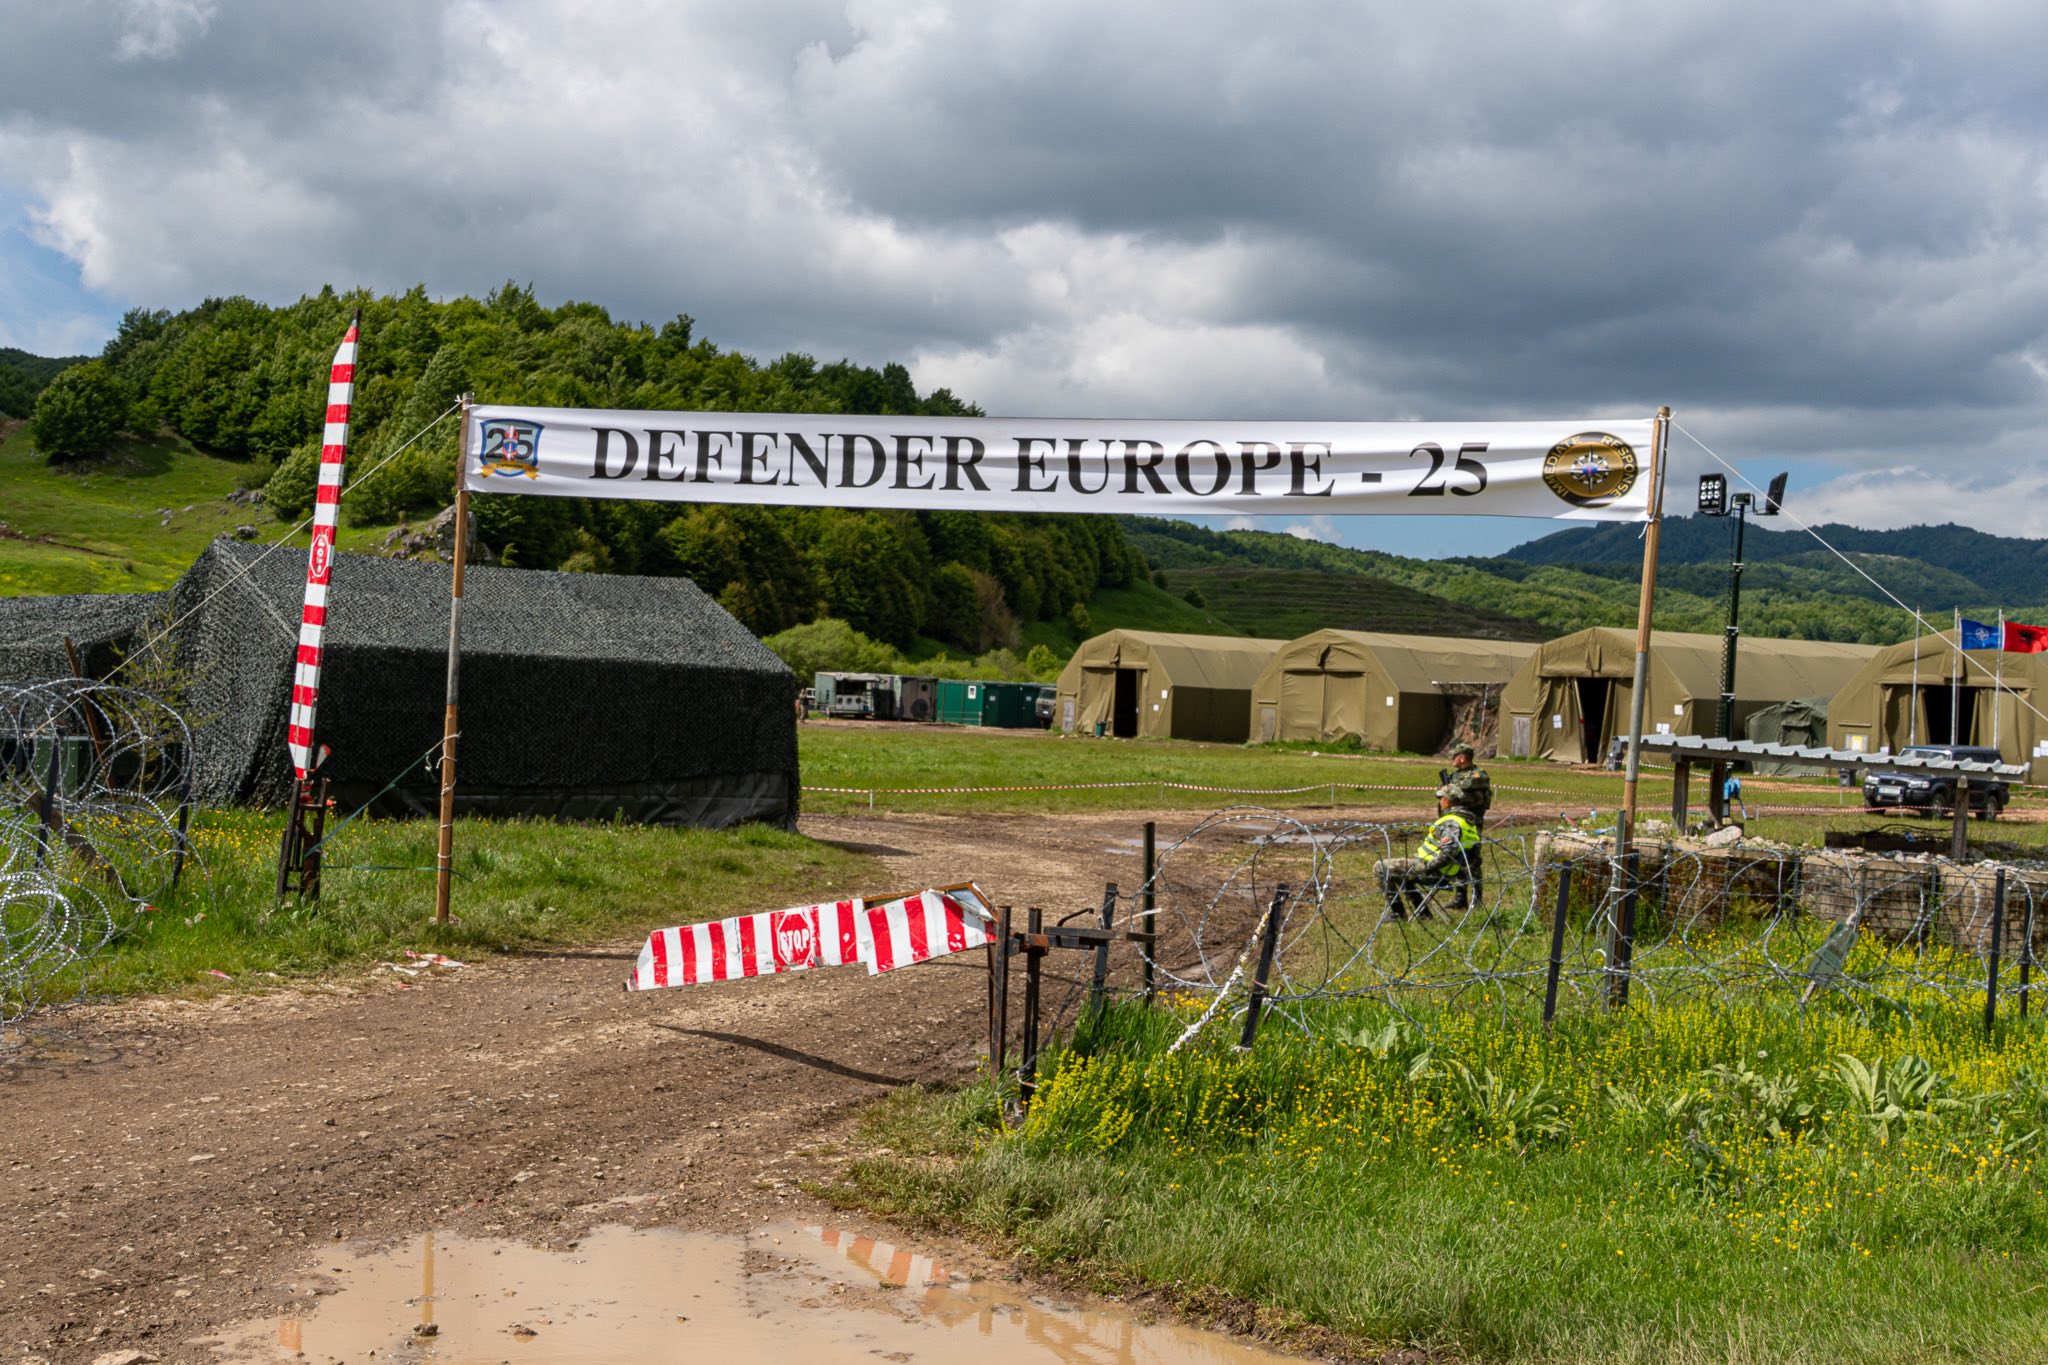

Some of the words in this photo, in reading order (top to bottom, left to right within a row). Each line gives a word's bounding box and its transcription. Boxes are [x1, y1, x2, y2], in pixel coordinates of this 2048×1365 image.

[486, 427, 534, 460] 25
[589, 427, 990, 491] DEFENDER
[1011, 436, 1336, 497] EUROPE
[1361, 472, 1383, 483] -
[1407, 441, 1490, 497] 25
[1543, 435, 1582, 497] IMMEDIATE
[1600, 435, 1635, 498] RESPONSE
[780, 928, 810, 953] STOP
